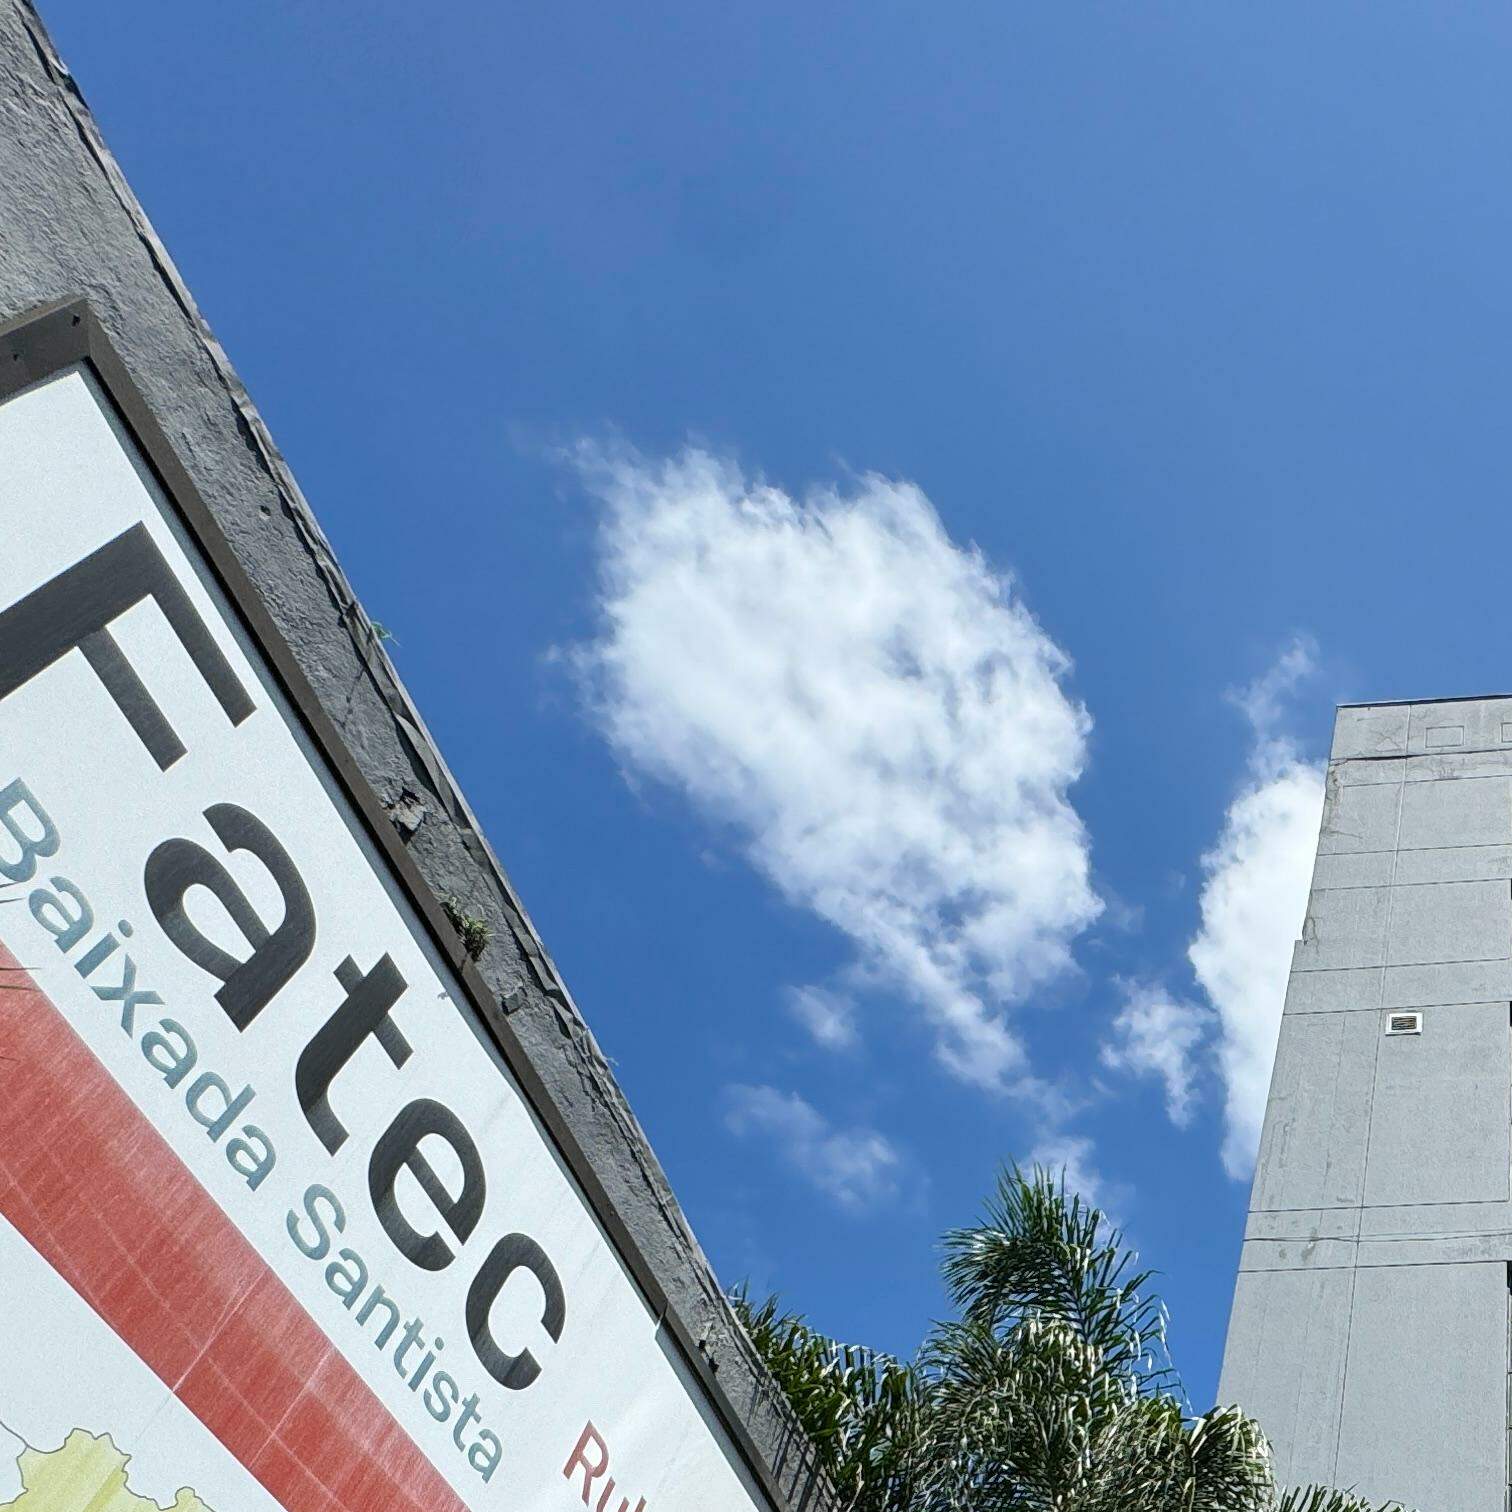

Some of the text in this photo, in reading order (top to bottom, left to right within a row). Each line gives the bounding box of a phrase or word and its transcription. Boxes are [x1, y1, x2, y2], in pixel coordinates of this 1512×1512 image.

[0, 521, 566, 1390] Fatec
[0, 777, 503, 1483] Baixada Santista
